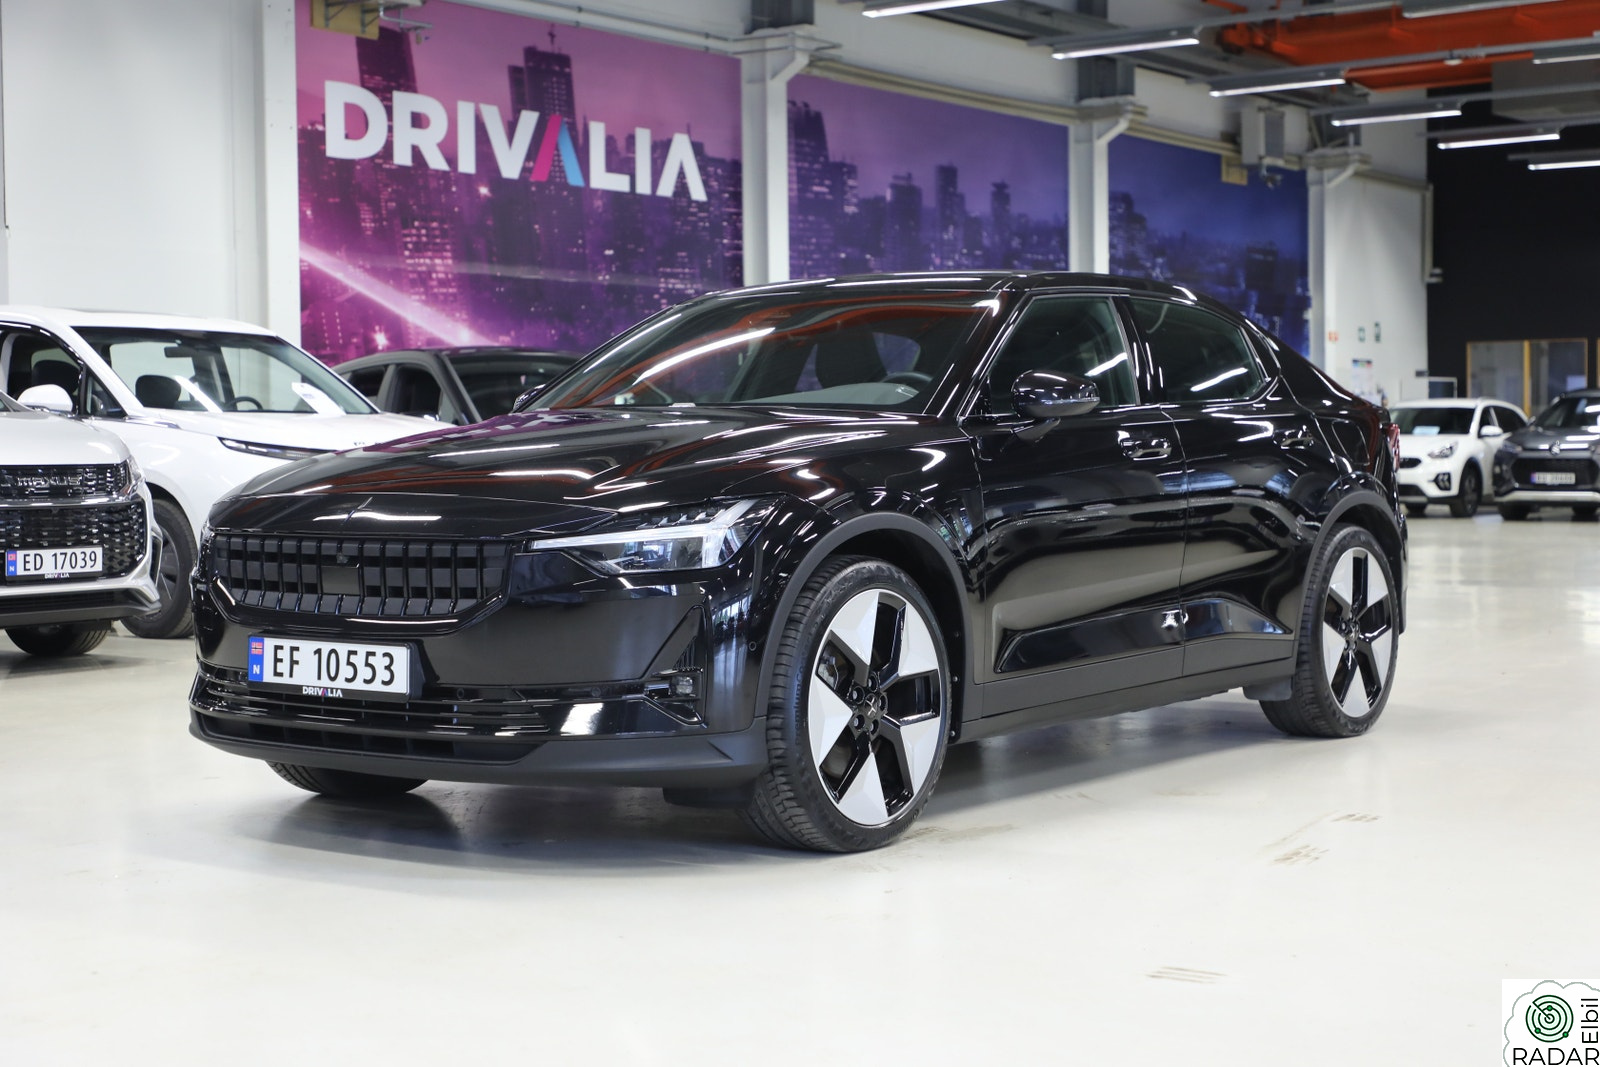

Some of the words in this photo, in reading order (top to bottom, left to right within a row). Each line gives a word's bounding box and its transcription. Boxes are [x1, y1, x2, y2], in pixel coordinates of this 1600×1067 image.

[324, 80, 708, 202] DRIVALIA
[23, 553, 43, 572] ED
[52, 551, 97, 570] 17039
[252, 664, 260, 675] N
[273, 644, 300, 678] EF
[313, 648, 395, 686] 10553
[302, 686, 343, 698] DRIVALIA
